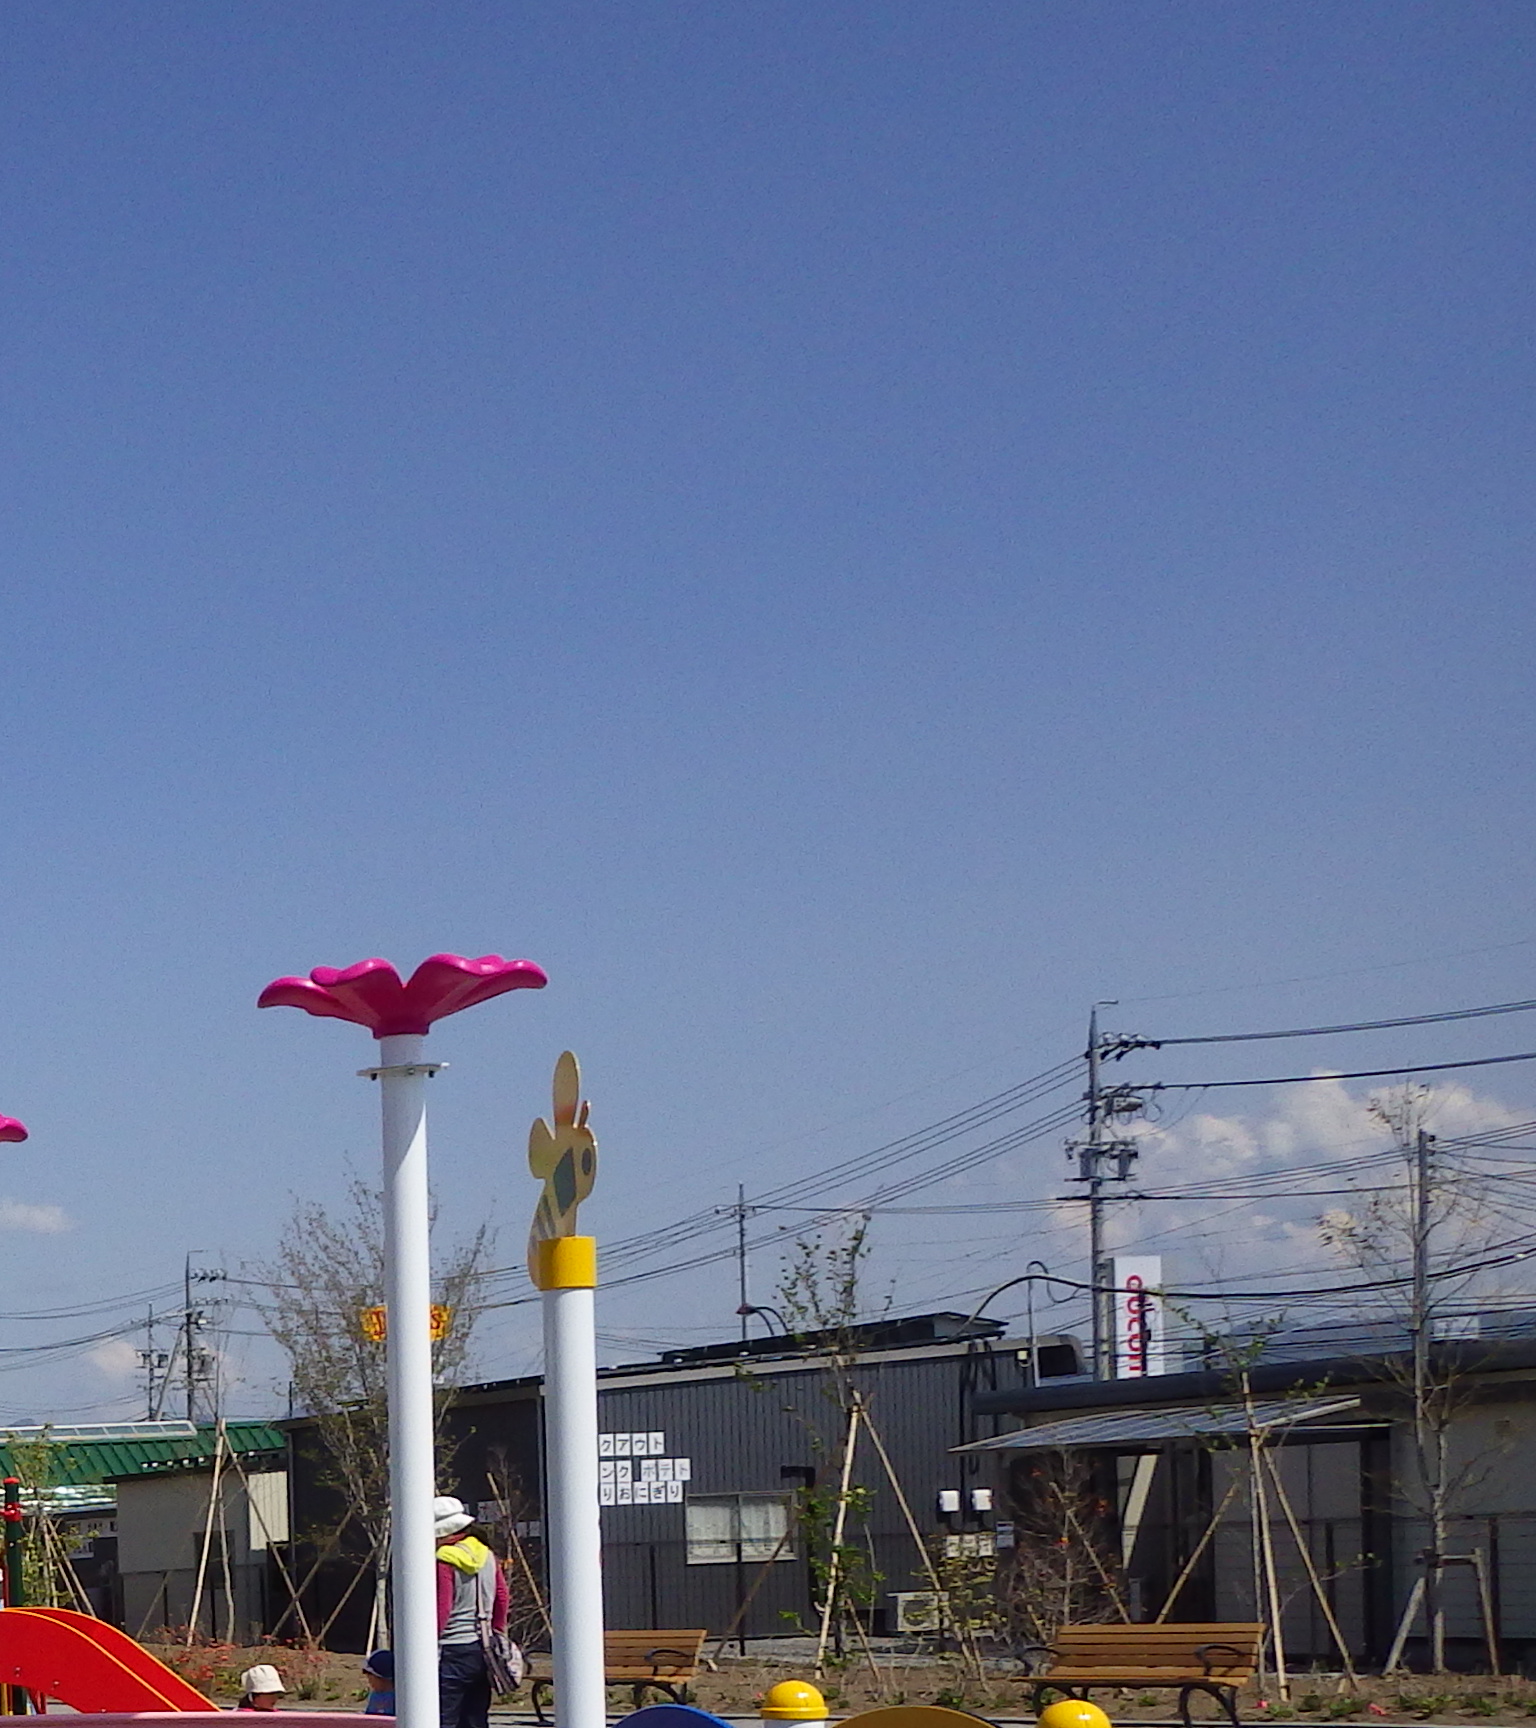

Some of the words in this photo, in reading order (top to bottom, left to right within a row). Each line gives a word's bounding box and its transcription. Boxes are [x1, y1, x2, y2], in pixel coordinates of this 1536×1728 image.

[601, 1437, 663, 1452] クアウト
[602, 1484, 681, 1502] りおにぎり
